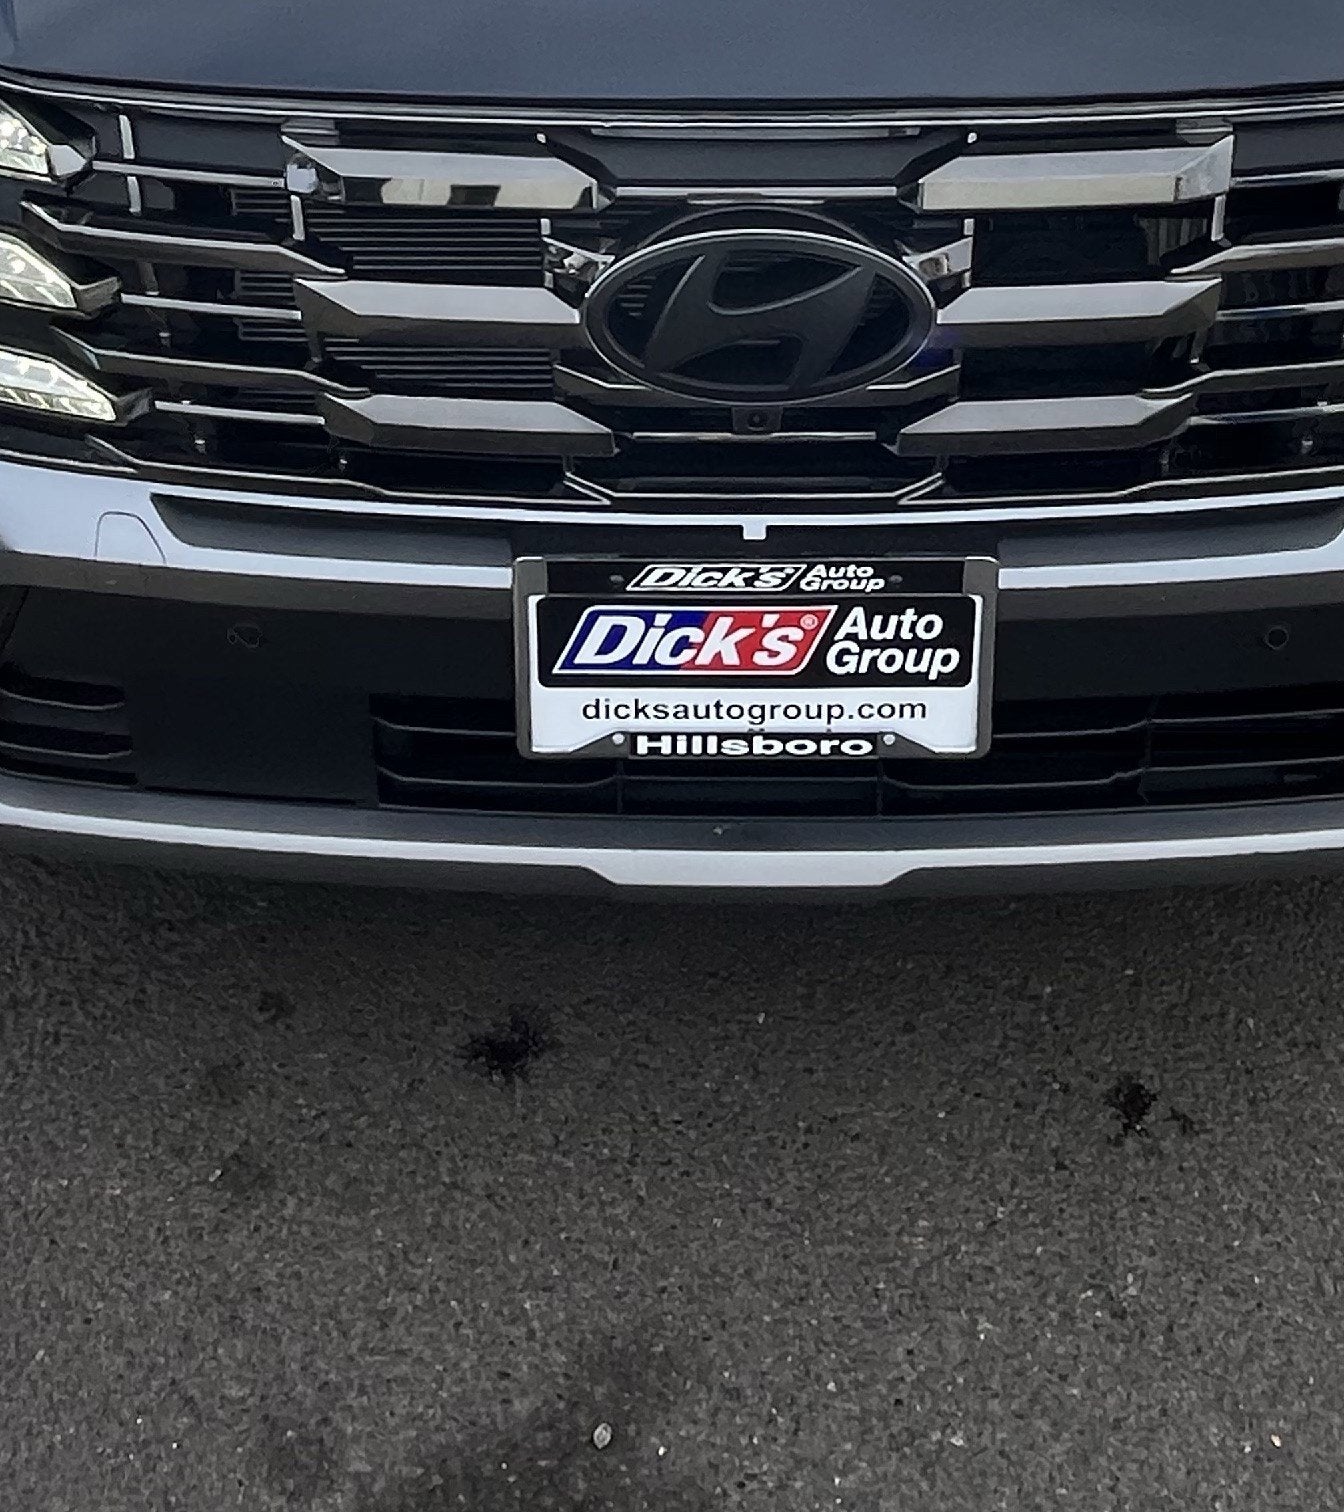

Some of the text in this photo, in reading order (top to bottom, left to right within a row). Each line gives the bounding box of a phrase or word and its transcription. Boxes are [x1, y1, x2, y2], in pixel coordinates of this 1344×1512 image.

[809, 564, 874, 578] Auto
[800, 577, 885, 592] Group
[834, 607, 943, 641] Auto
[826, 641, 960, 680] Group
[582, 698, 927, 725] dicksautogroup.com
[636, 734, 874, 756] Hillsboro
